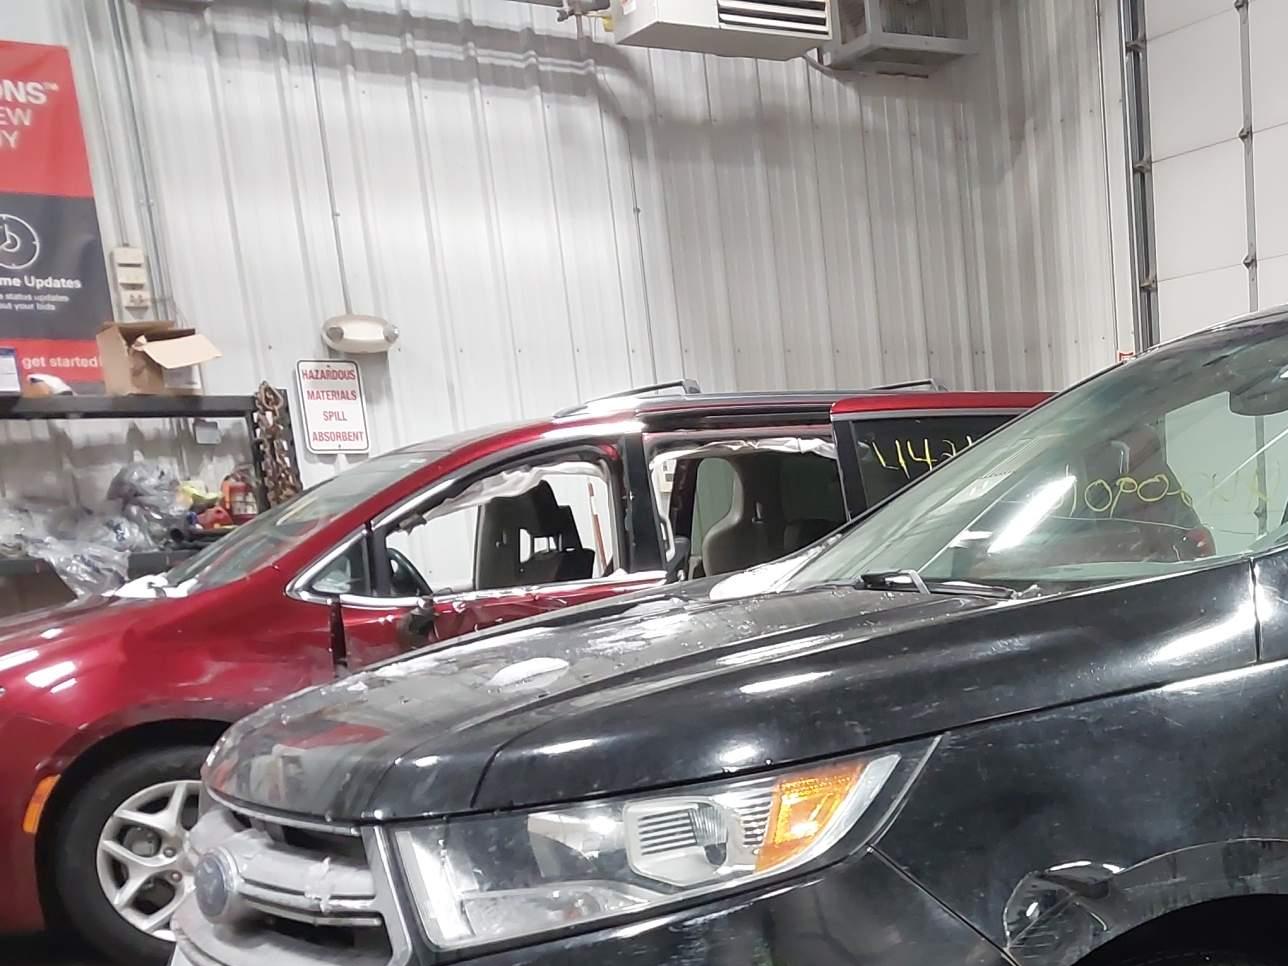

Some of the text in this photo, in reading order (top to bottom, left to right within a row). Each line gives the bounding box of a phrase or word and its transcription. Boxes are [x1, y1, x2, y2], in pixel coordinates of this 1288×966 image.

[24, 275, 81, 290] Updates
[22, 356, 46, 370] get
[302, 369, 356, 380] HAZARDOUS
[307, 390, 357, 401] MATERIALS
[322, 411, 348, 422] SPILL
[312, 431, 364, 442] ABSORBENT
